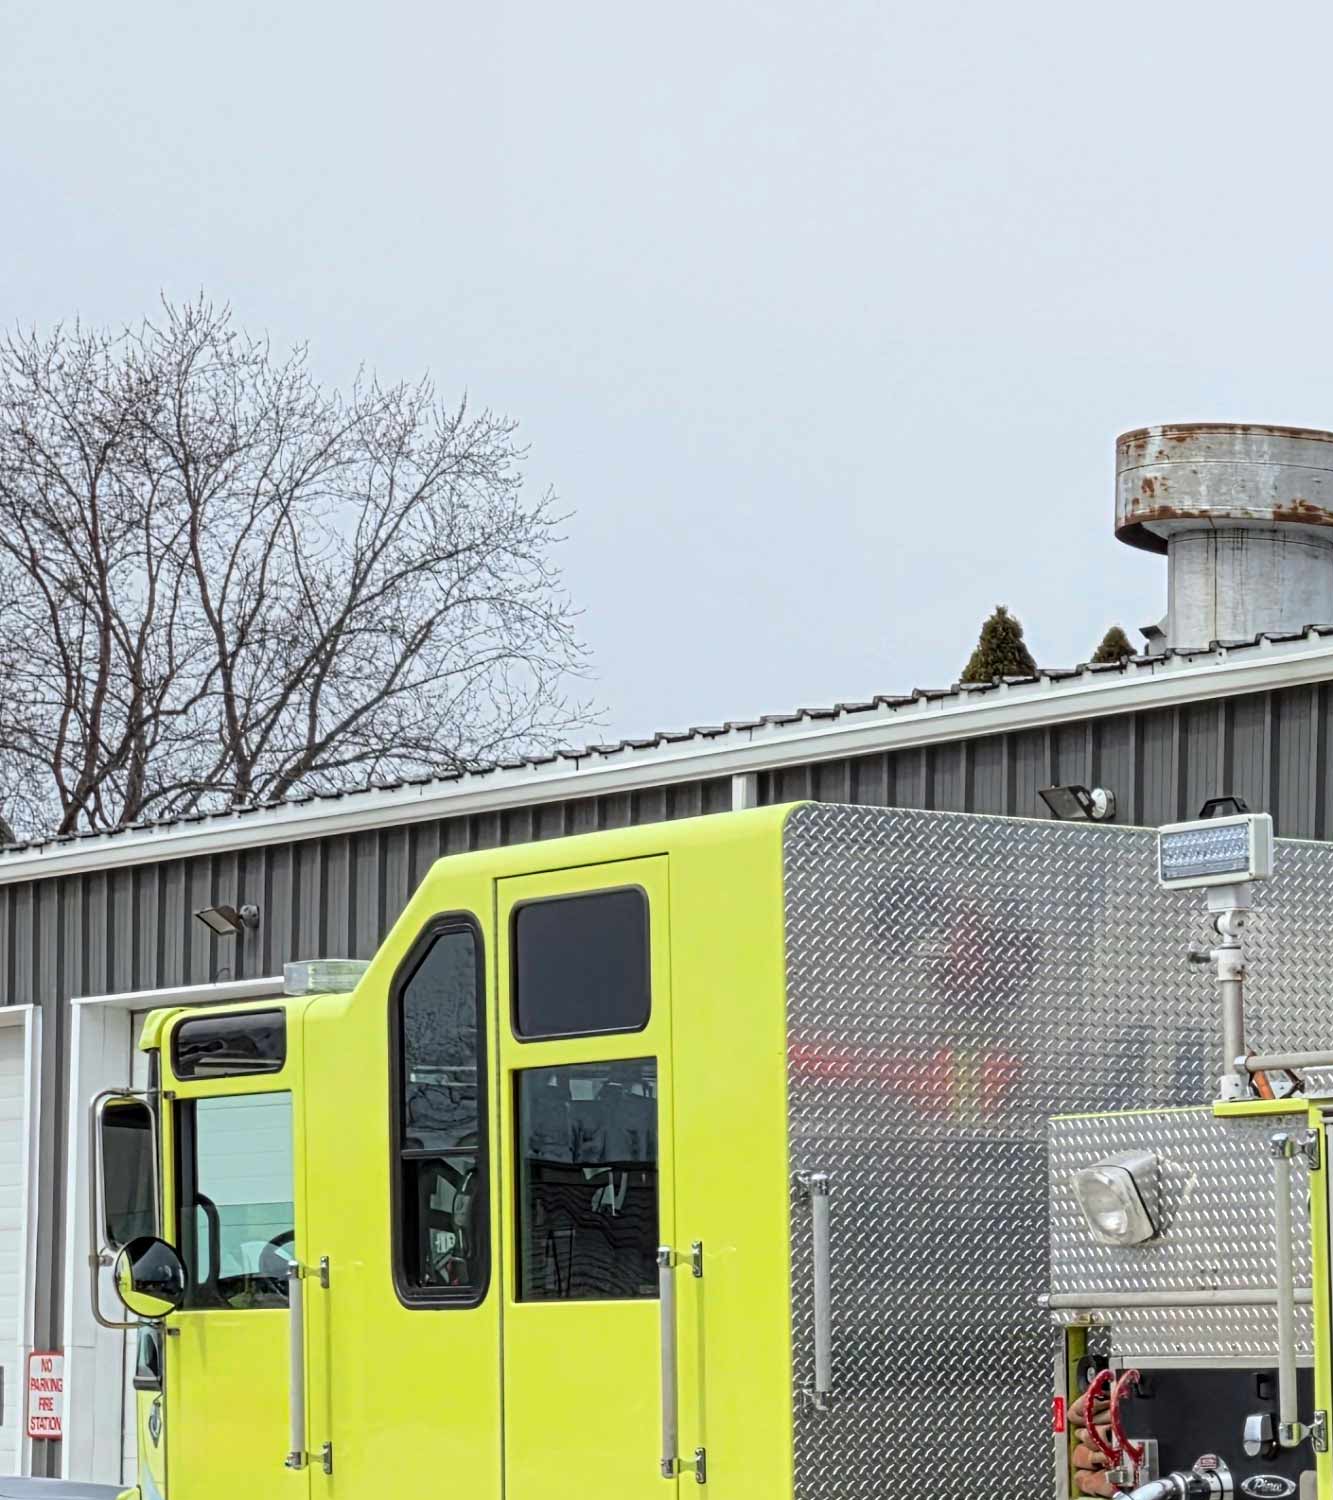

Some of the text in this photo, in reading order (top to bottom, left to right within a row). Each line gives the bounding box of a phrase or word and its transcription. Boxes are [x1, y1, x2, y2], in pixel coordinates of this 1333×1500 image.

[41, 1358, 53, 1373] NO
[30, 1378, 63, 1393] PARKING
[38, 1397, 54, 1411] FIRE
[30, 1416, 62, 1430] STATION
